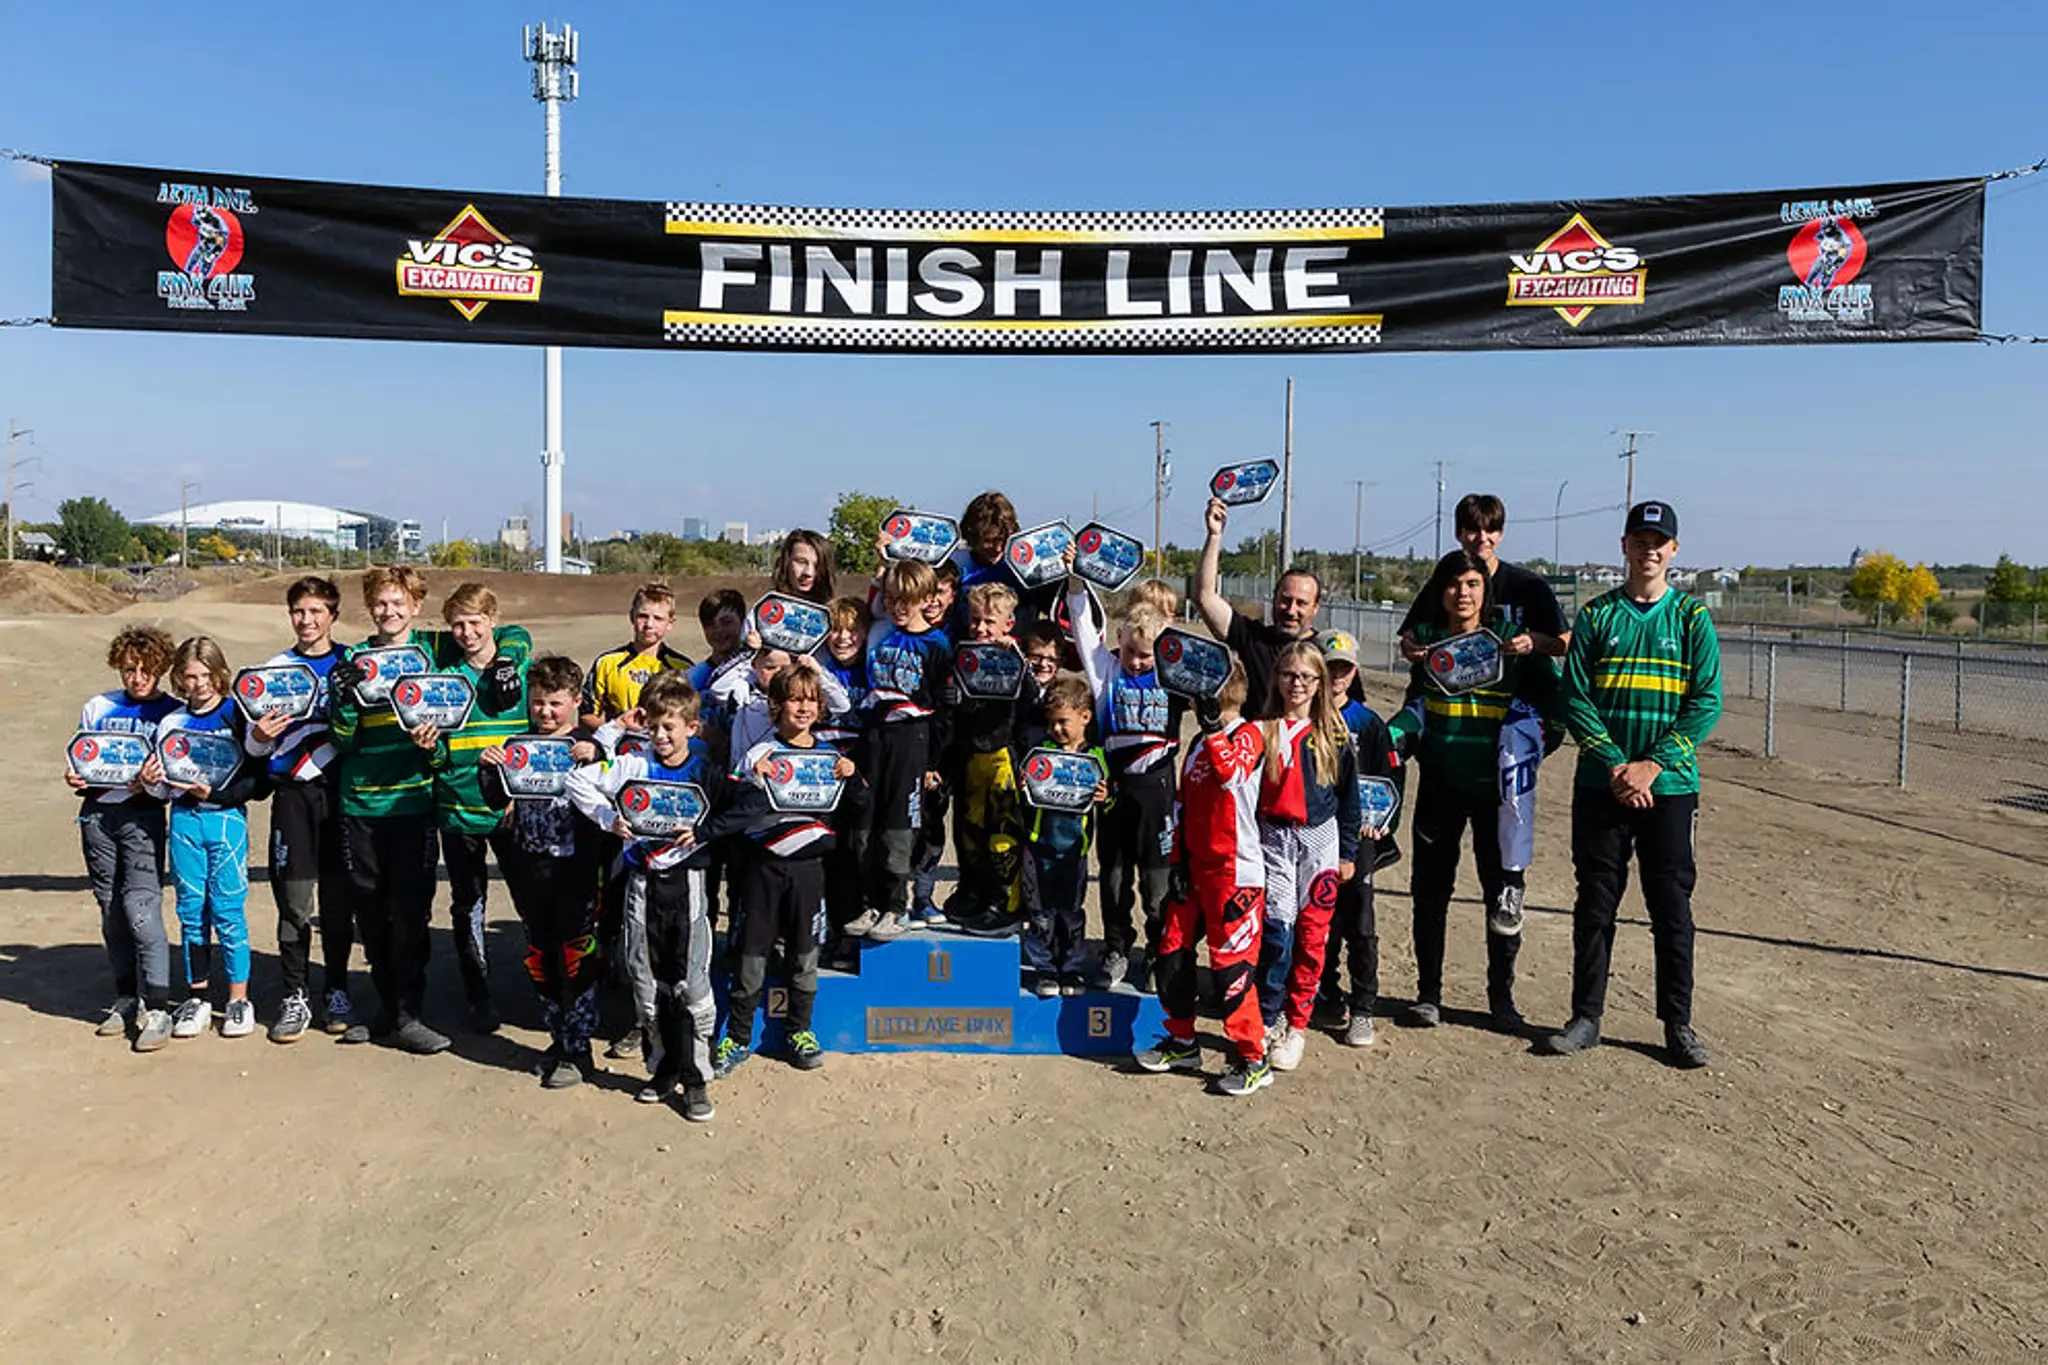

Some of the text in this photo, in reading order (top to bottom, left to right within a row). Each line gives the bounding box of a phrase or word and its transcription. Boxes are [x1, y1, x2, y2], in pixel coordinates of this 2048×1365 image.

[407, 239, 534, 271] VIC'S
[1509, 247, 1639, 274] VIC'S
[157, 270, 255, 301] BMX CLUB
[407, 268, 530, 293] EXCAVATING
[699, 241, 1350, 317] FINISH LINE
[1518, 276, 1635, 297] EXCAVATING
[1778, 284, 1874, 312] BMX CLUB
[933, 955, 946, 979] 1
[772, 990, 787, 1014] 2
[924, 1014, 961, 1035] AVE
[966, 1016, 1006, 1034] BMX
[1092, 1010, 1106, 1034] 3
